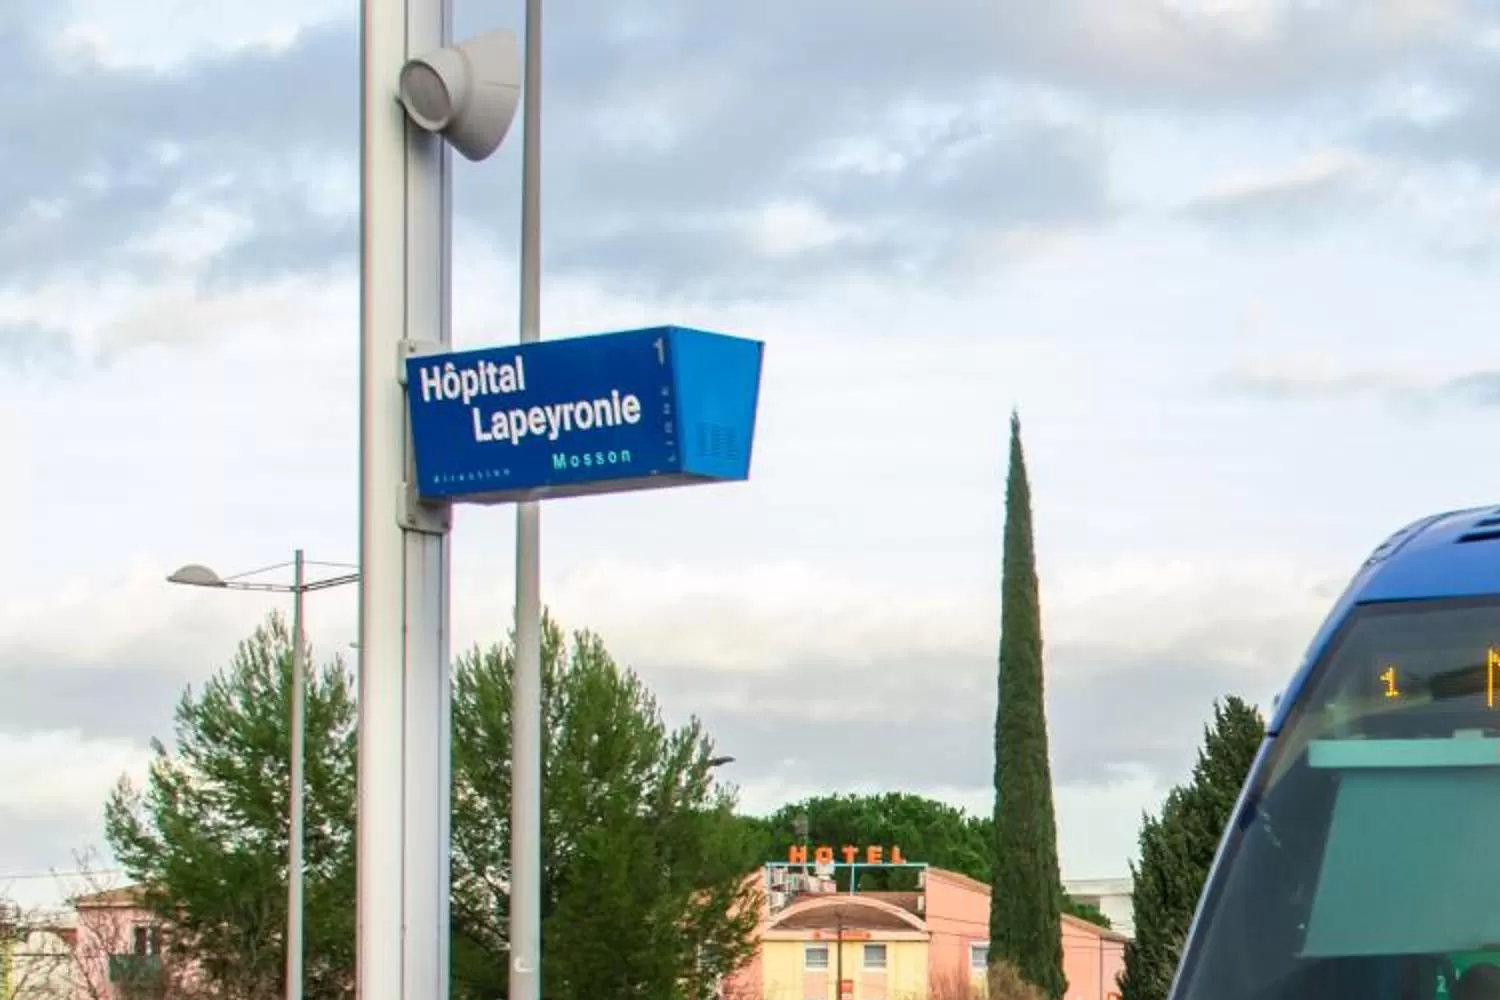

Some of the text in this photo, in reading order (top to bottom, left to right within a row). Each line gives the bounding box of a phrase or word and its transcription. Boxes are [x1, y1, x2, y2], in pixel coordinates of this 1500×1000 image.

[652, 337, 665, 365] 1
[419, 355, 526, 405] Hôpital
[472, 388, 642, 445] Lapeyronie
[551, 449, 632, 471] Mosson
[1379, 666, 1399, 697] 1
[788, 843, 908, 865] HOTEL
